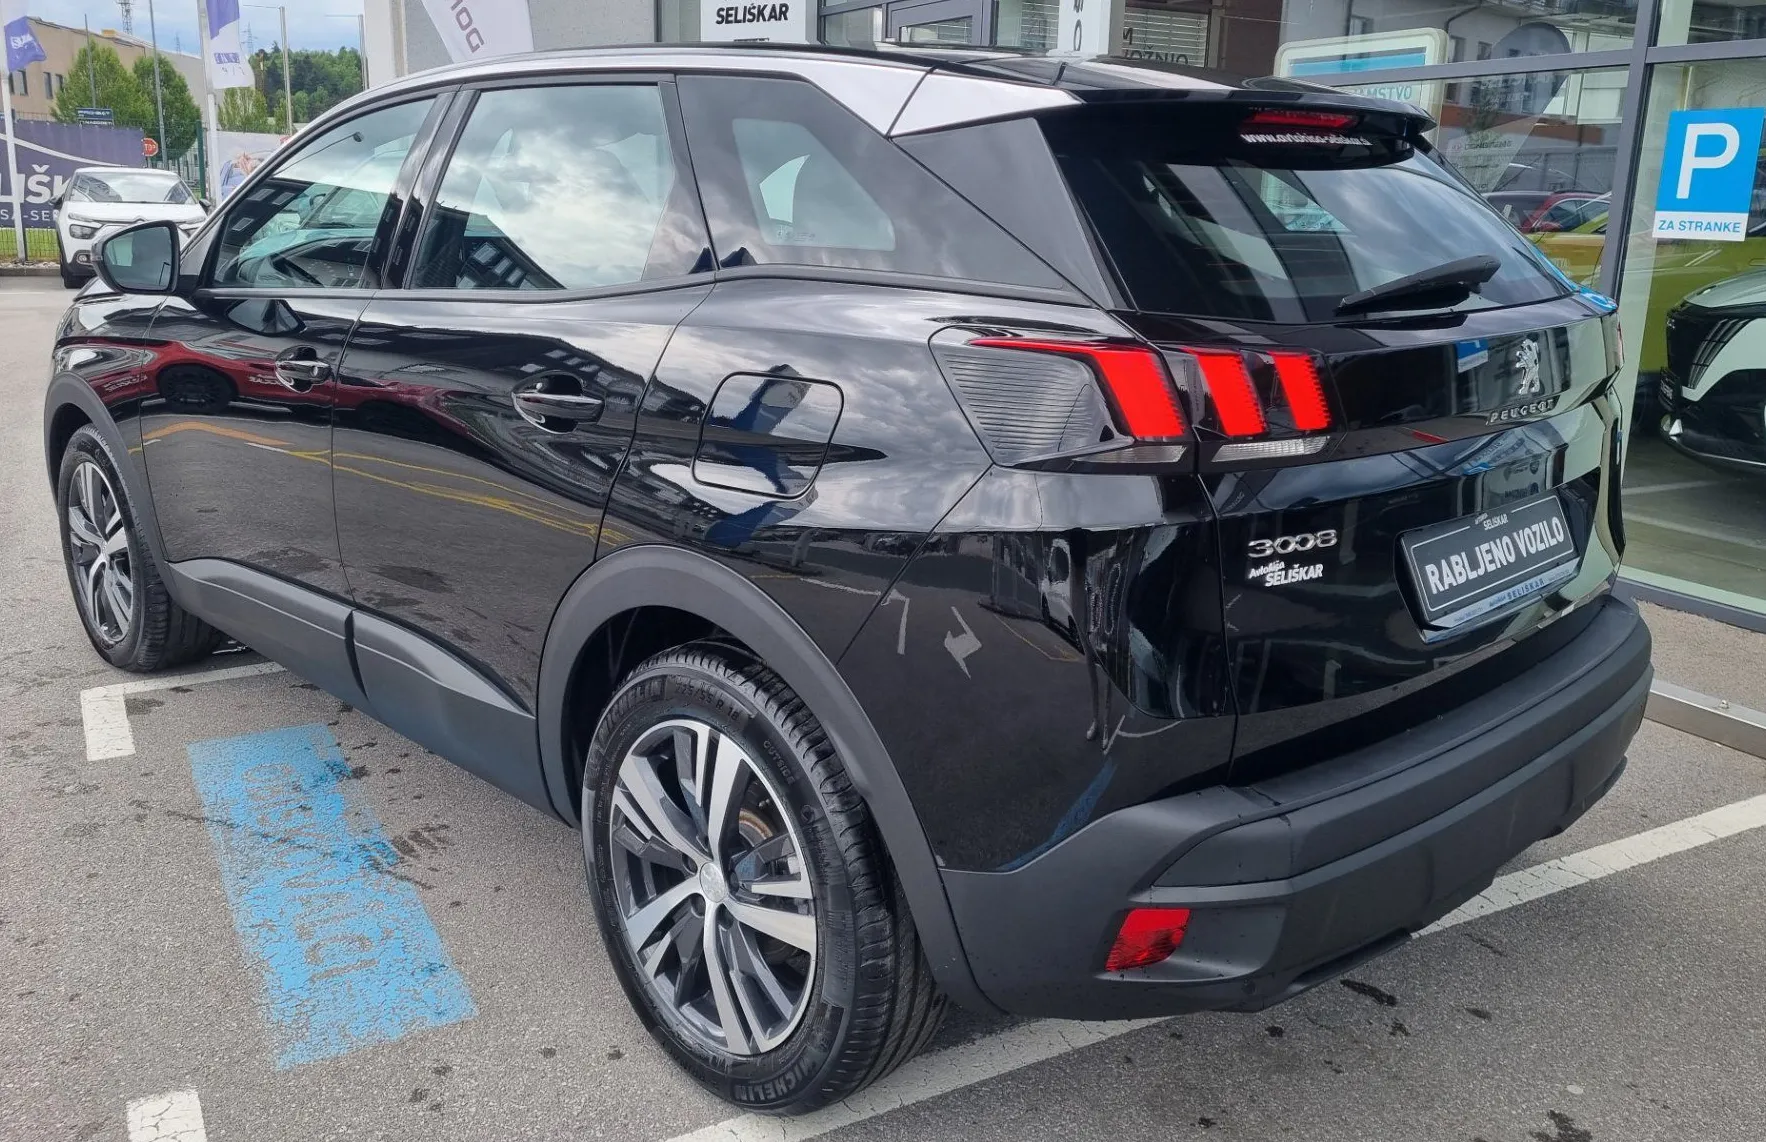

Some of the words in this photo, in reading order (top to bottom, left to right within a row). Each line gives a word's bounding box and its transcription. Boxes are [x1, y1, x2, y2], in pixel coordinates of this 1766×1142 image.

[715, 3, 790, 25] SELIŠKAR
[1676, 122, 1740, 199] P
[1658, 220, 1675, 232] ZA
[1677, 220, 1742, 234] STRANKE
[1490, 399, 1554, 423] PEUGEOT
[1248, 529, 1338, 558] 3008
[1425, 535, 1516, 595] RABLJENO
[1512, 516, 1565, 558] VOZILO
[1264, 563, 1324, 587] SELIŠKAR
